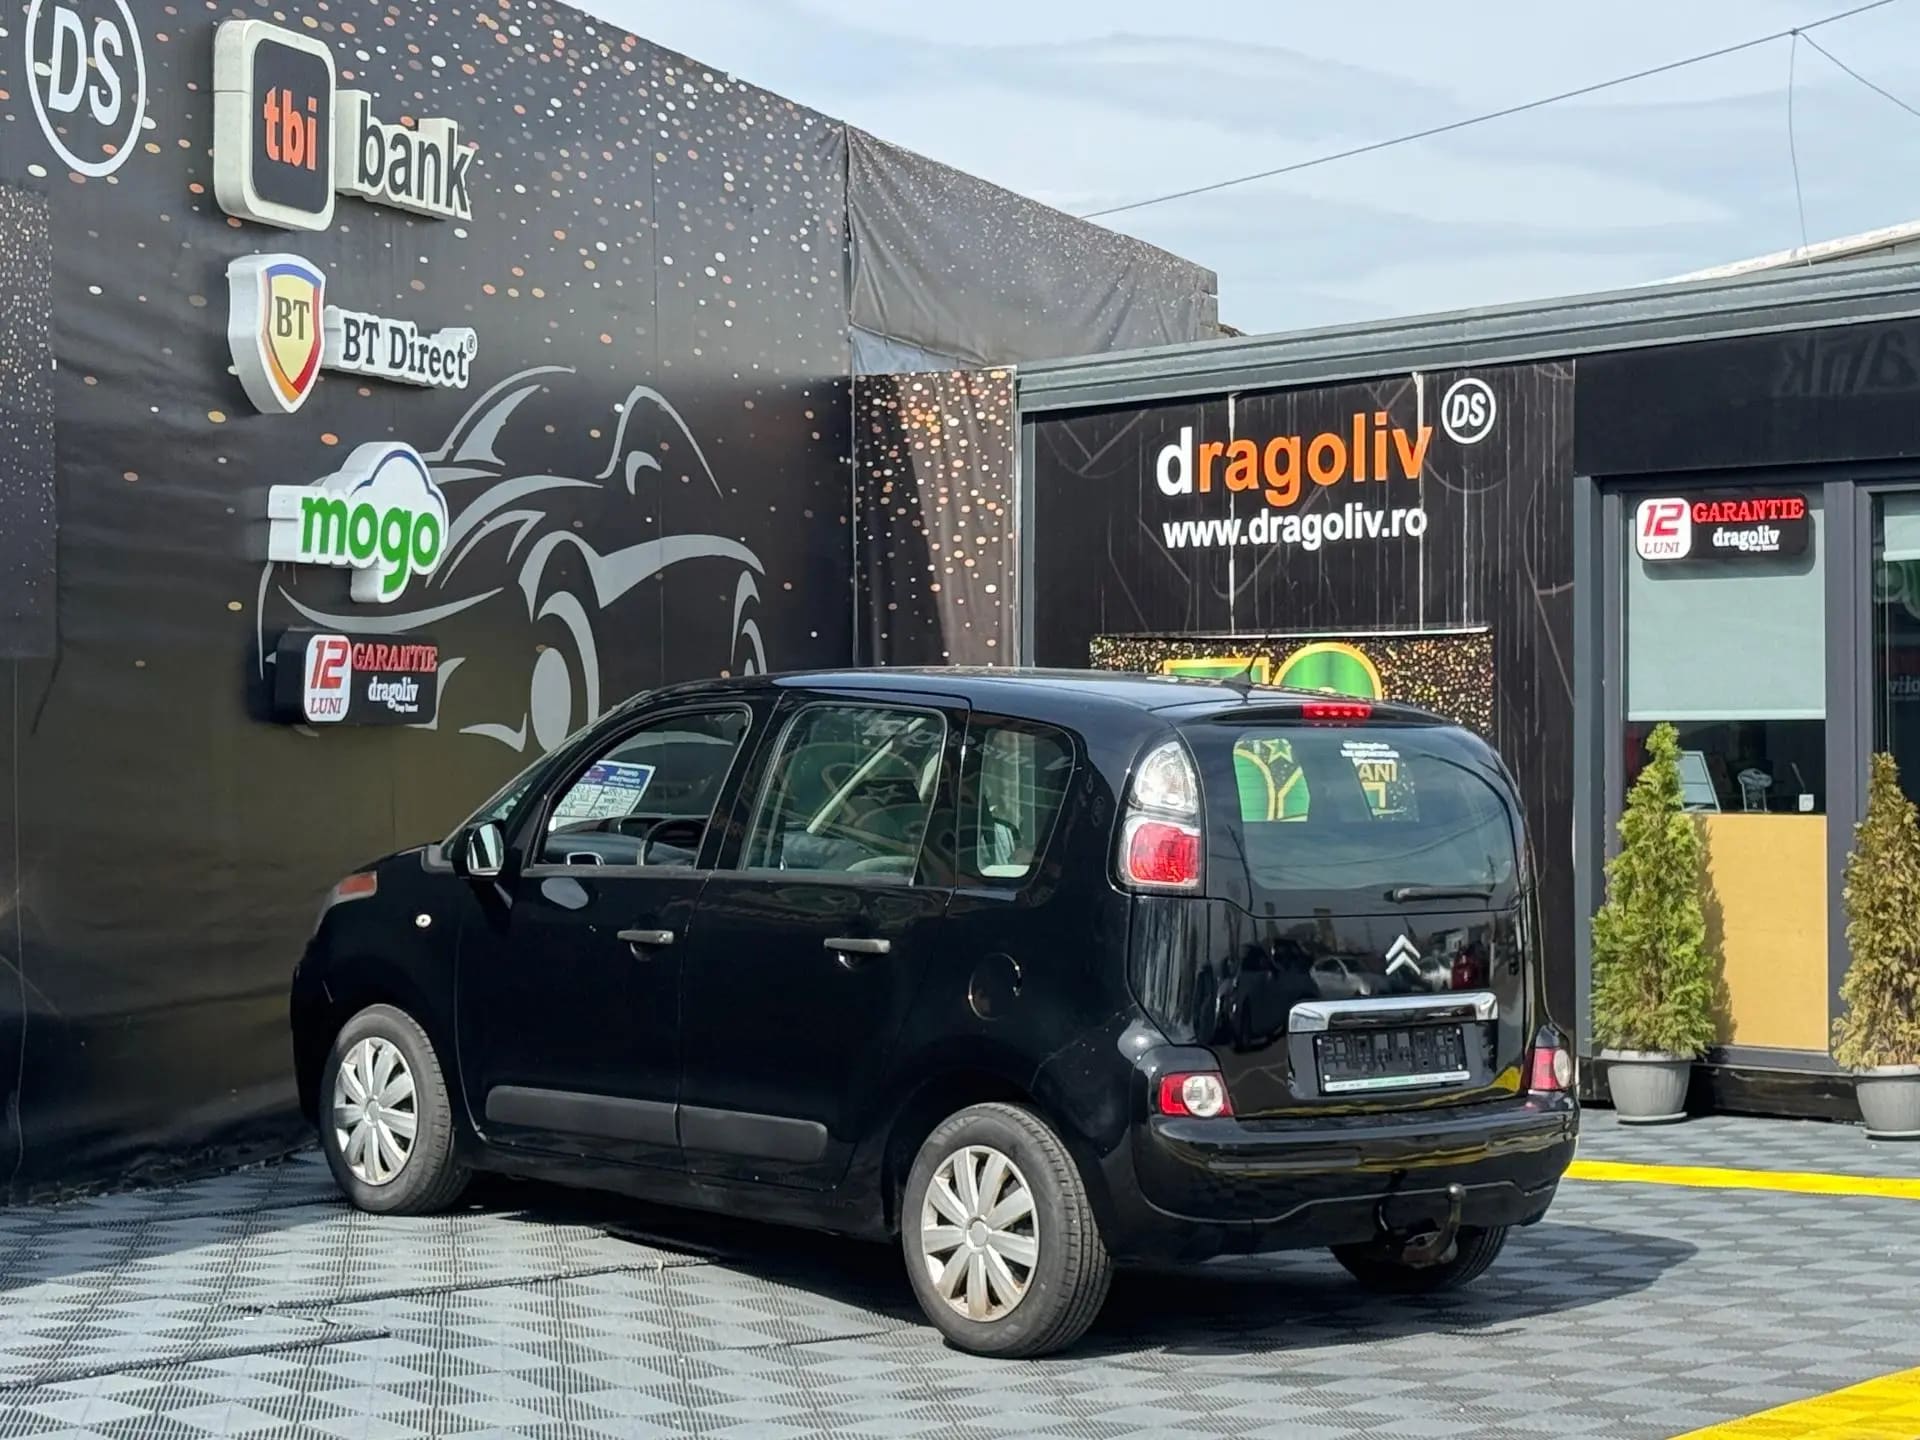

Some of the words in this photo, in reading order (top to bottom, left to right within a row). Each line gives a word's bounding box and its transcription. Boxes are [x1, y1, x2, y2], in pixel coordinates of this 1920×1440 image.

[48, 6, 124, 126] DS
[263, 86, 318, 171] tbi
[358, 98, 473, 213] bank
[275, 295, 310, 340] BT
[343, 317, 380, 366] BT
[1451, 392, 1487, 428] DS
[1156, 411, 1433, 507] dragoliv
[1163, 502, 1428, 551] www.dragoliv.ro
[1643, 504, 1684, 537] 12
[1692, 499, 1804, 524] GARANTIE
[301, 495, 441, 595] mogo
[1643, 542, 1681, 554] LUNI
[1712, 525, 1780, 551] dragoliv
[310, 640, 349, 689] 12
[352, 643, 438, 673] GARANTIE
[309, 697, 344, 715] LUNI
[368, 675, 419, 710] dragoliv
